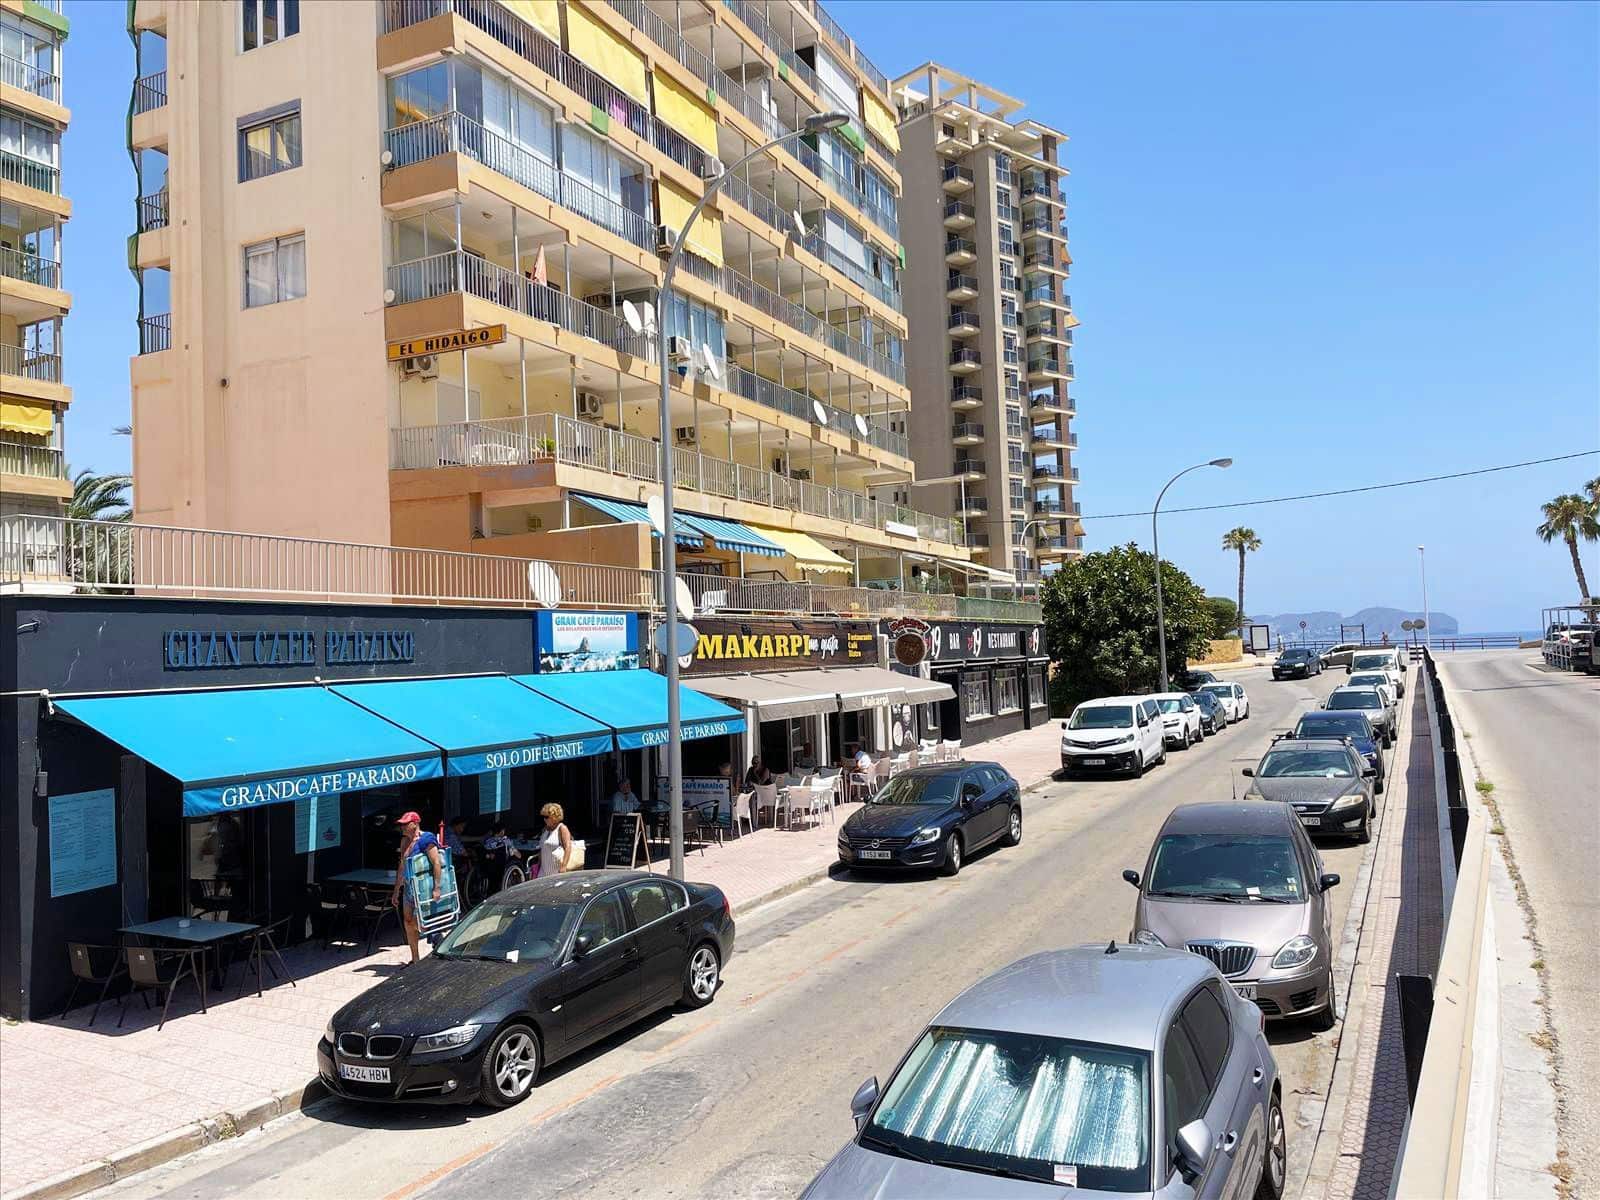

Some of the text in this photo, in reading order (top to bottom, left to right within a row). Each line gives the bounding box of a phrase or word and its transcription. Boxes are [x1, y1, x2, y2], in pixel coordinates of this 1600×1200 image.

[400, 330, 489, 355] EL HIDALGO
[167, 629, 415, 668] GRAN CAFE PARAISO
[696, 634, 811, 660] MAKARPI
[949, 632, 961, 650] BAR
[987, 632, 1017, 649] RESTAURANT
[694, 722, 728, 739] PARAISO
[486, 741, 585, 769] SOLO DIFERENTE
[222, 763, 417, 807] GRANDCAFE PARAISO
[346, 1066, 388, 1081] 4524 HBM
